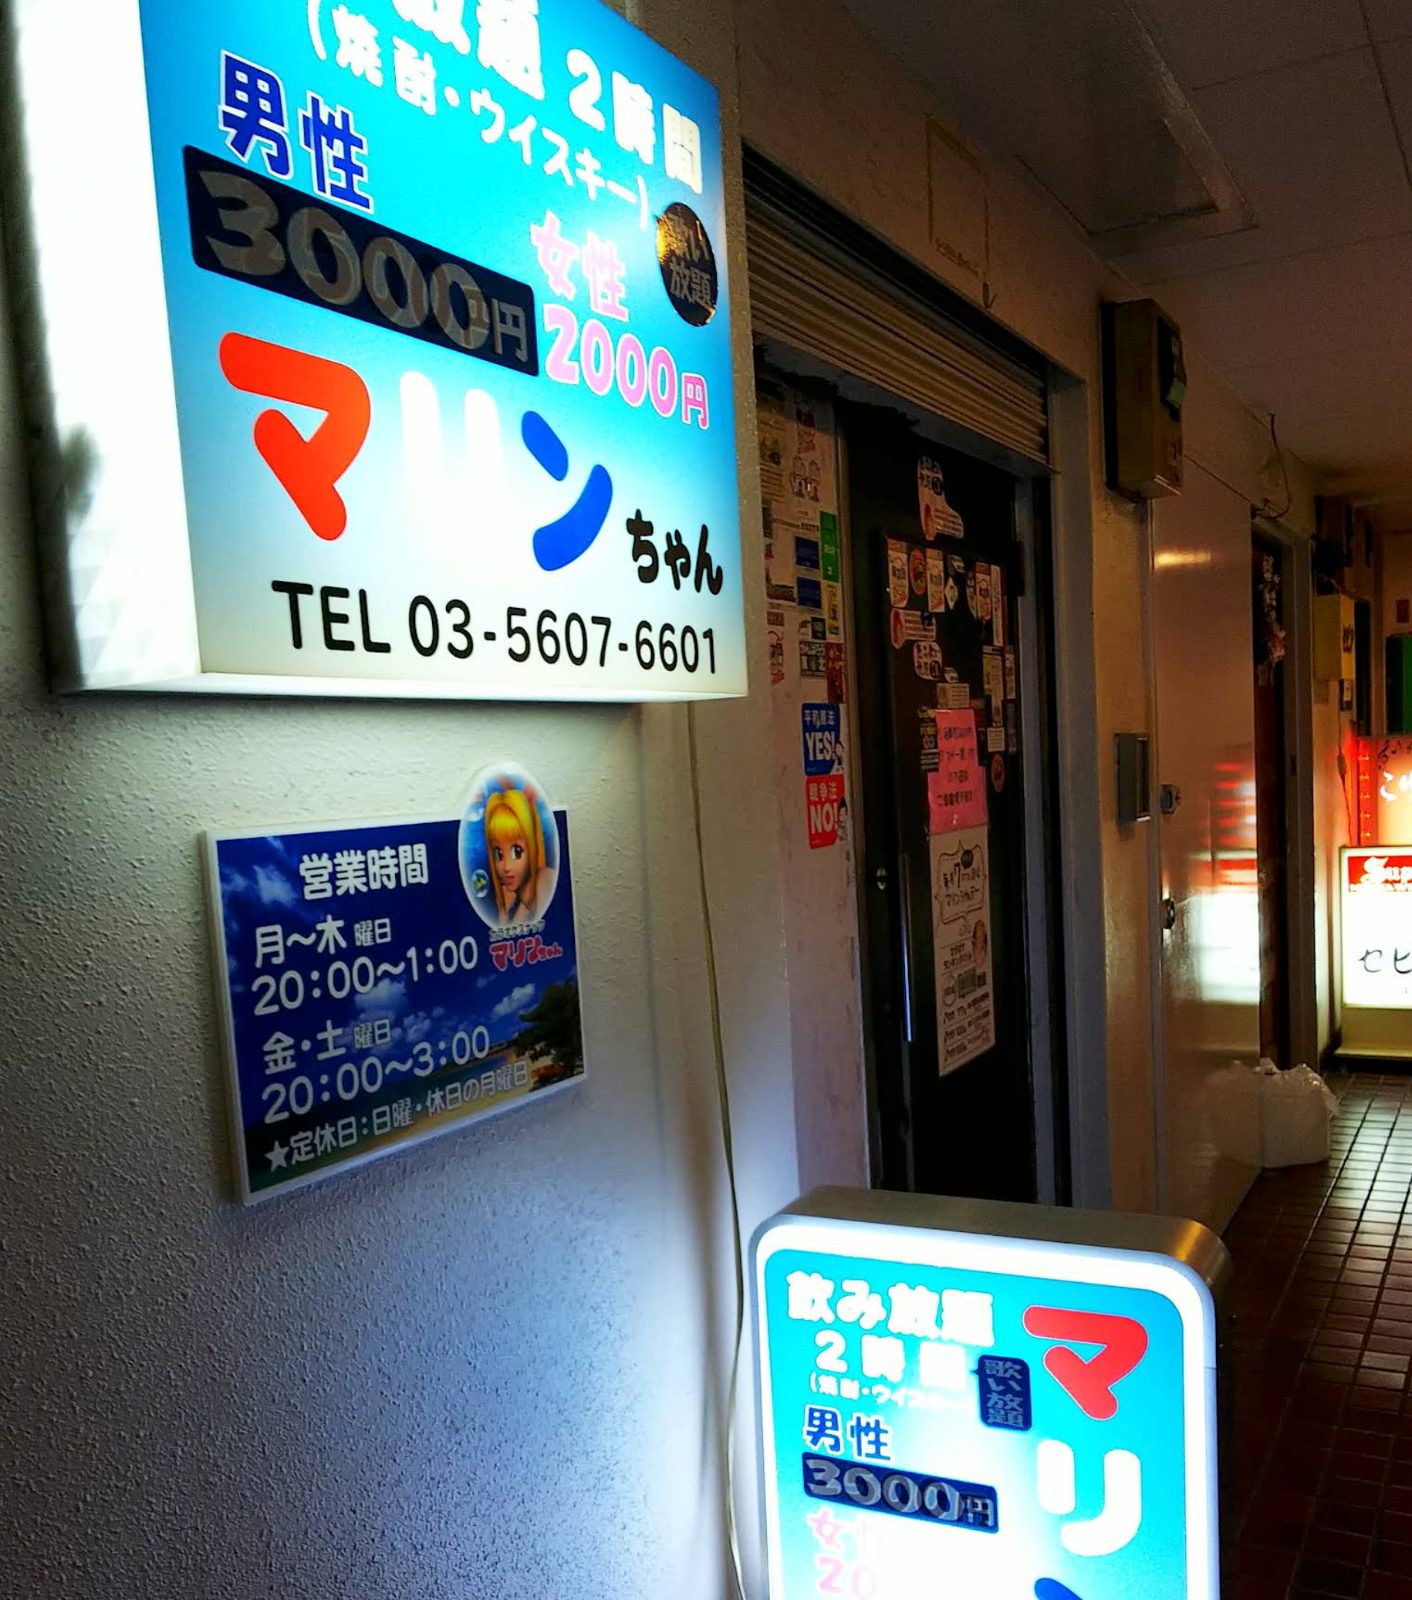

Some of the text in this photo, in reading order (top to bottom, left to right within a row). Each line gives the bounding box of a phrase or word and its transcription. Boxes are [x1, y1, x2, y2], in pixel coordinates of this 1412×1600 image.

[218, 50, 374, 213] 男性
[568, 49, 703, 194] 2時間
[197, 170, 529, 363] 3000円
[530, 209, 629, 322] 女性
[543, 303, 710, 430] 2000円
[271, 580, 391, 653] TEL
[409, 595, 717, 674] 03-5607-6601
[805, 731, 836, 761] YES!
[809, 801, 839, 834] NO!
[300, 842, 430, 900] 営業時間
[354, 918, 393, 948] 曜日
[354, 1018, 392, 1050] 曜日
[802, 1403, 892, 1461] 男性
[806, 1458, 995, 1528] 3000円
